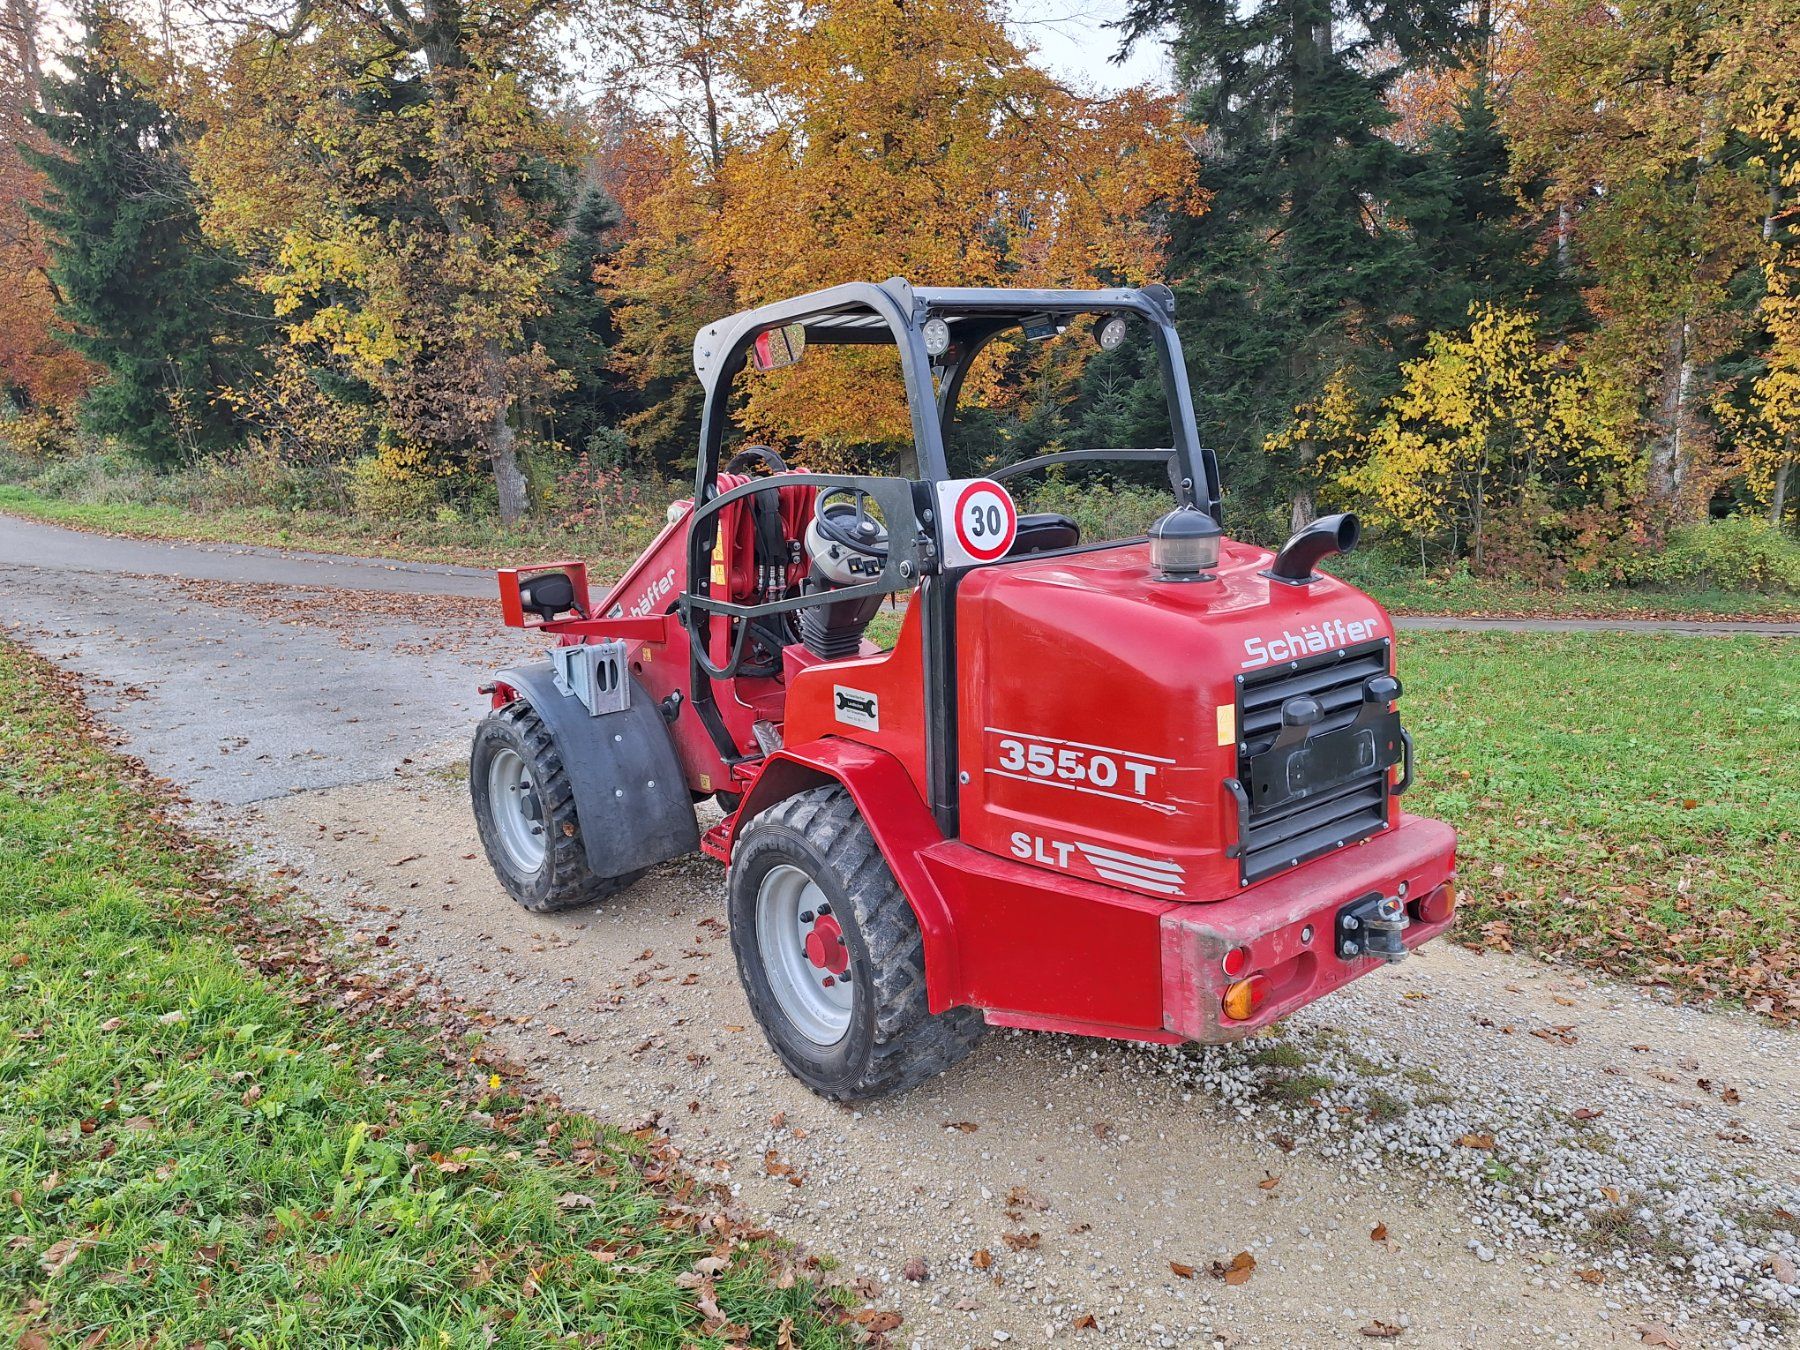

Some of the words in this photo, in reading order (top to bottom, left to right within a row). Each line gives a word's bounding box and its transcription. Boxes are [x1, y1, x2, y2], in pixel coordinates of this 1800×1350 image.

[971, 505, 1001, 537] 30
[629, 568, 676, 618] häffer
[1240, 618, 1379, 669] Schäffer
[999, 739, 1118, 787] 3550
[1125, 761, 1157, 796] T
[1010, 831, 1075, 869] SLT
